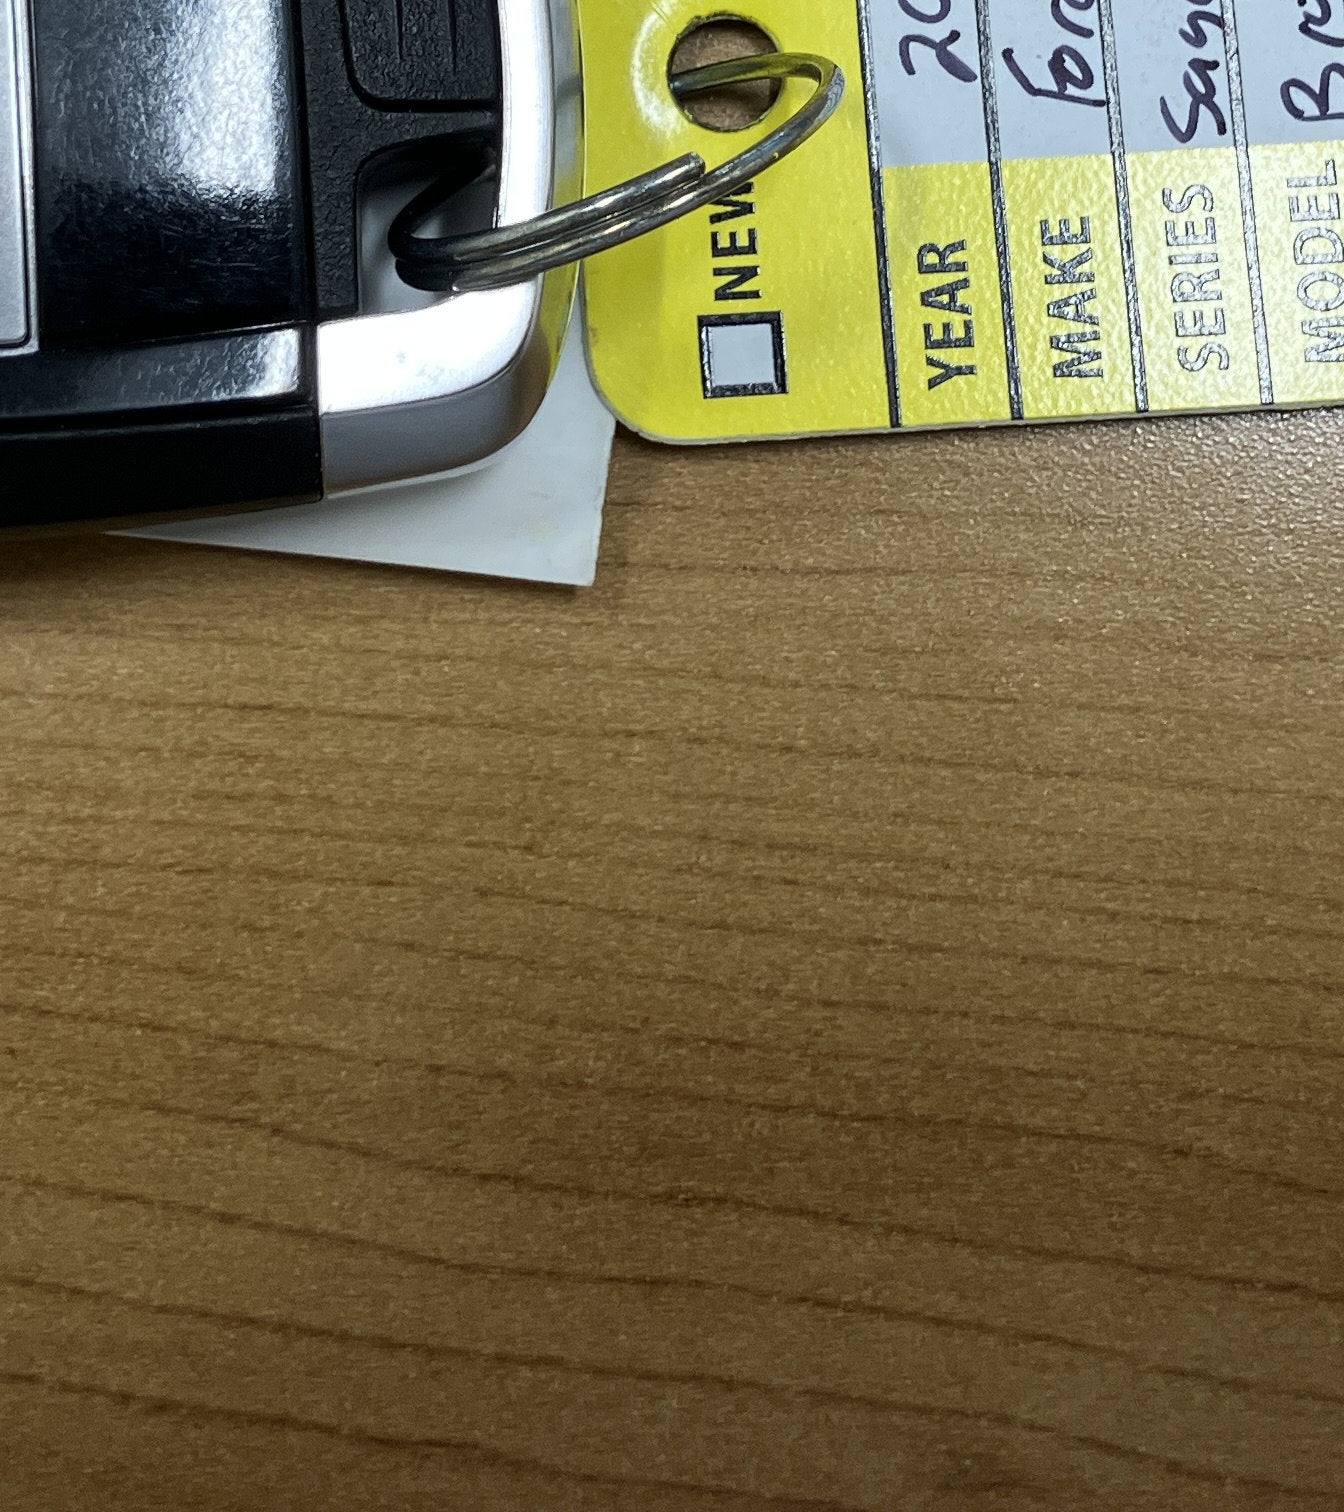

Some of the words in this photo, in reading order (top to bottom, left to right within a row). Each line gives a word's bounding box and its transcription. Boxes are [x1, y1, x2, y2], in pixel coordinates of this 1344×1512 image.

[917, 239, 976, 390] YEAR
[1042, 216, 1105, 379] MAKE
[1161, 183, 1230, 373] SERIES
